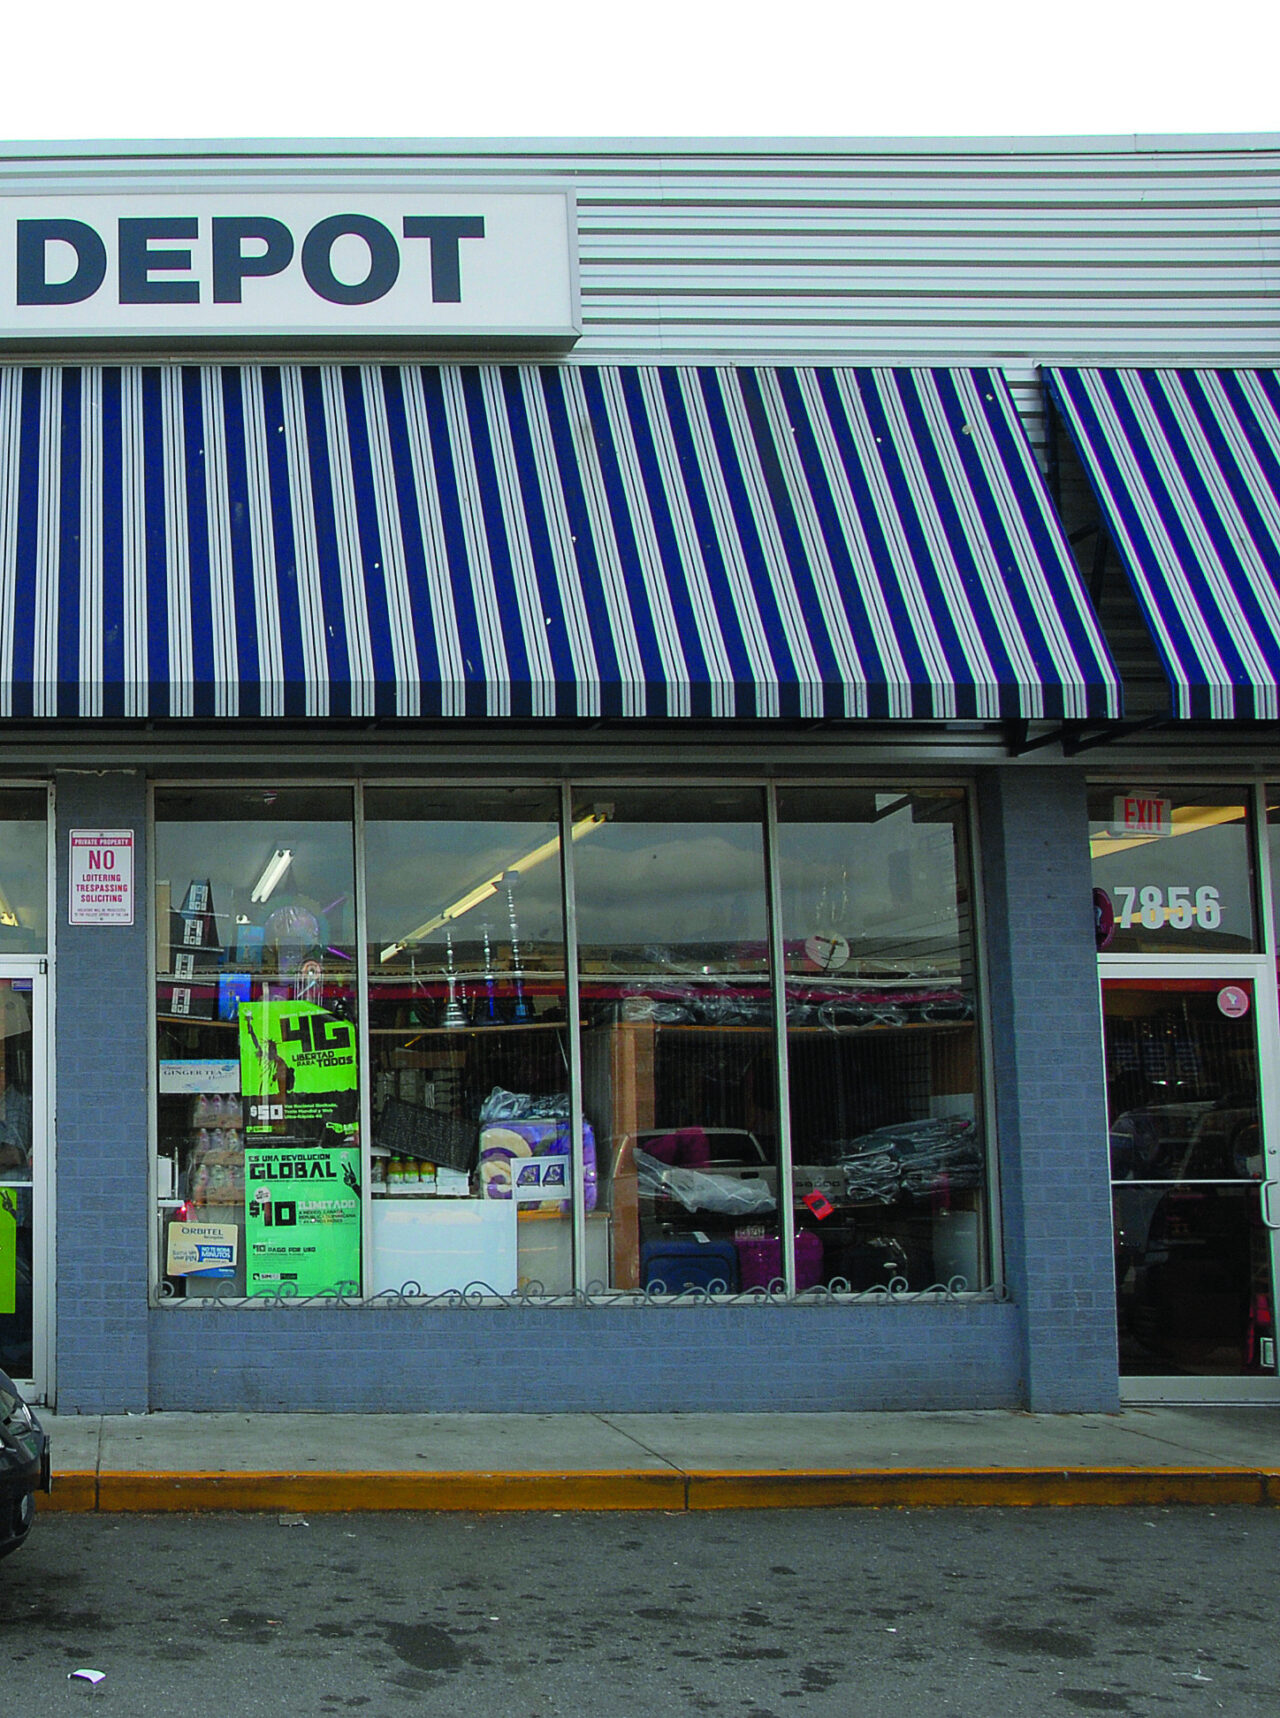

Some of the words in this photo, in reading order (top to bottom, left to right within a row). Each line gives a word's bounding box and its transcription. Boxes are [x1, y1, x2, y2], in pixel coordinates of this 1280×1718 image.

[16, 213, 485, 307] DEPOT
[1124, 797, 1164, 831] EXIT
[100, 838, 129, 846] PROPERTY
[88, 849, 115, 870] NO
[82, 873, 121, 882] LOITERING
[76, 883, 128, 893] TRESPASSING
[80, 894, 123, 903] SOLICITING
[1113, 885, 1221, 930] 7856
[280, 1014, 352, 1053] 4G
[291, 1050, 335, 1062] LIBERTAD
[317, 1055, 354, 1068] TODOS
[250, 1103, 284, 1120] $50
[261, 1154, 279, 1162] UNA
[249, 1161, 337, 1180] GLOBAL
[249, 1200, 297, 1227] $10
[298, 1200, 357, 1210] ILIMITADO
[181, 1227, 224, 1236] ORBITEL
